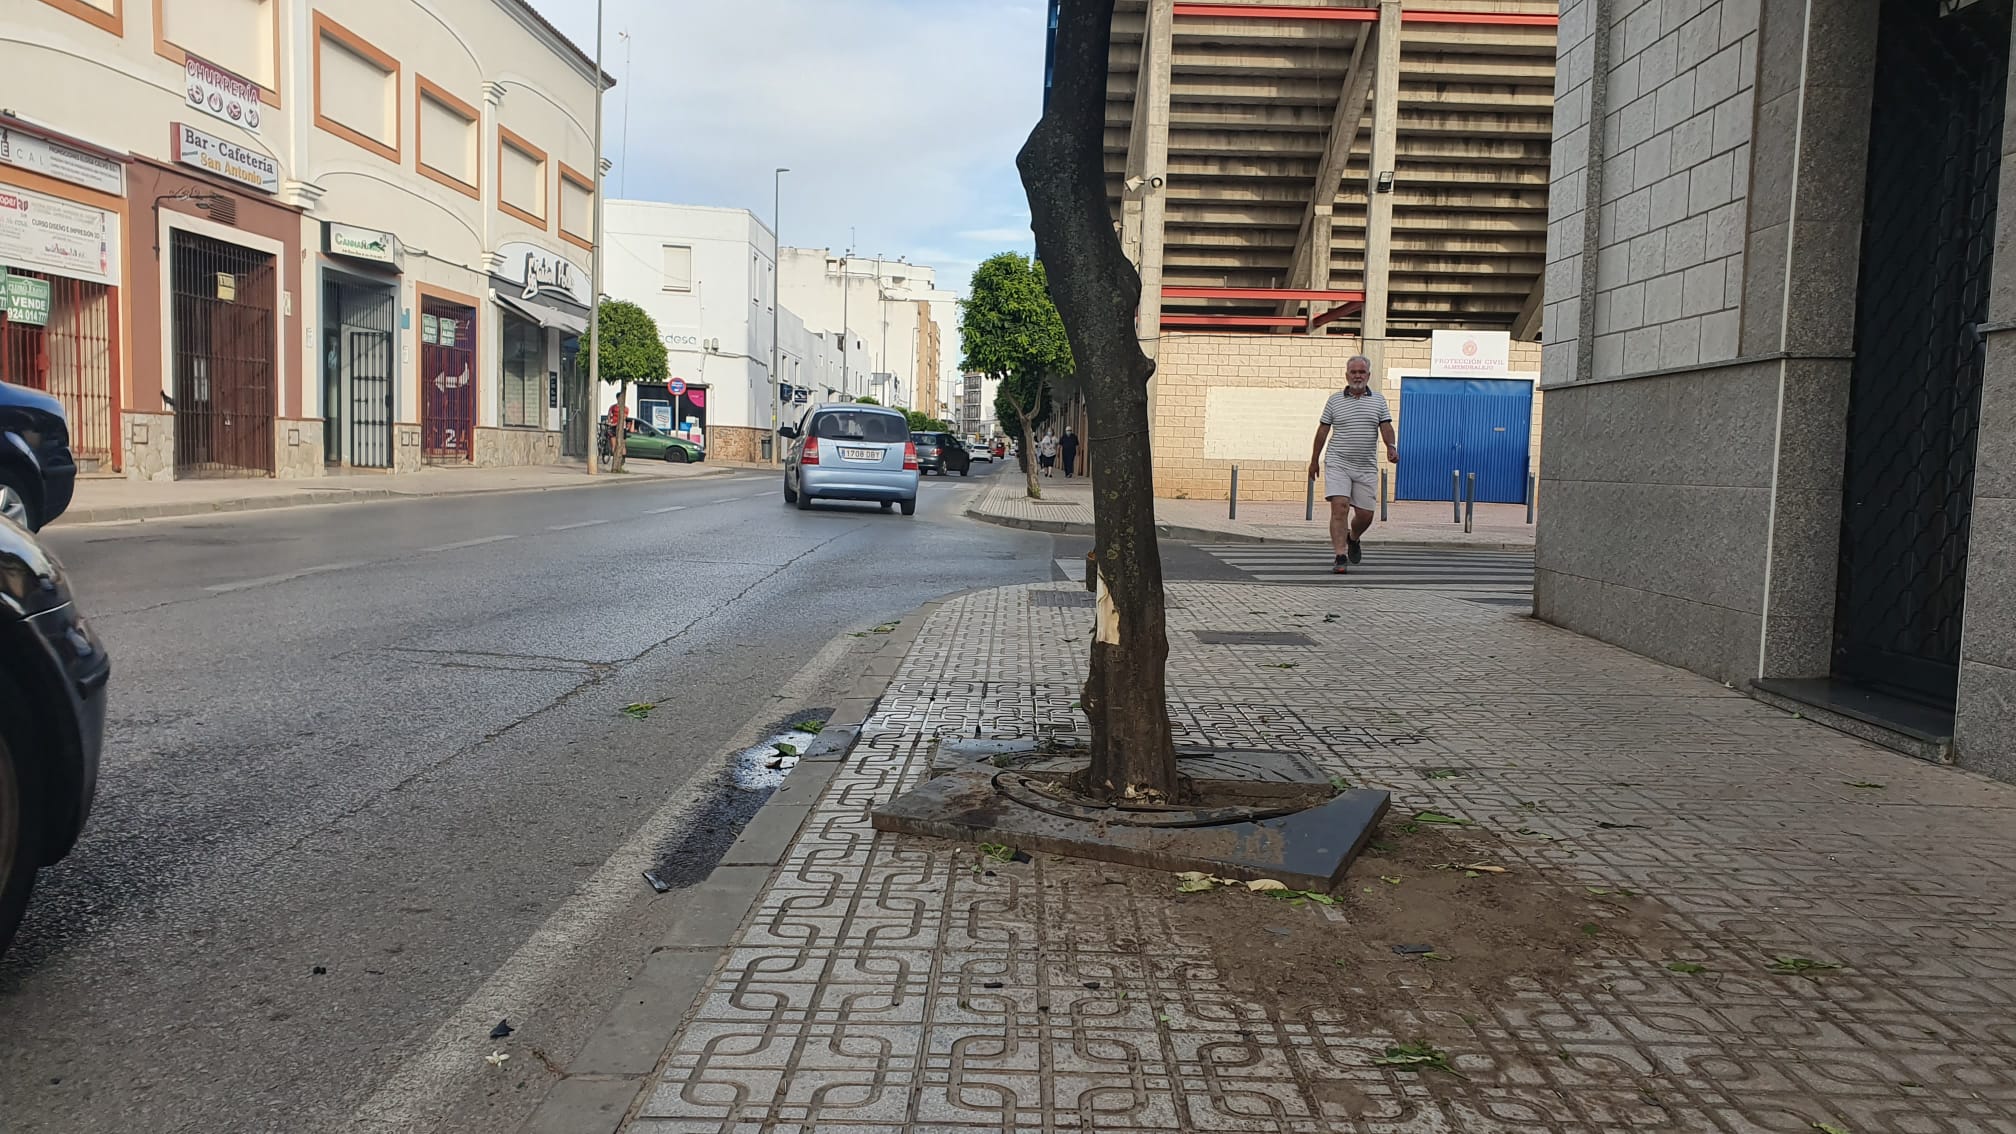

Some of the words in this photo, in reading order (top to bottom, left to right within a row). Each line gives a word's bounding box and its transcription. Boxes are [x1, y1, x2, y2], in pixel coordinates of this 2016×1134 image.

[186, 59, 259, 105] CHURRERÍA
[185, 128, 208, 149] Bar
[218, 142, 274, 174] Cafetería
[200, 151, 221, 171] San
[224, 161, 262, 185] Antonio
[7, 307, 24, 319] 924
[11, 295, 46, 310] VENDE
[1434, 357, 1482, 365] PROTECCIÓN
